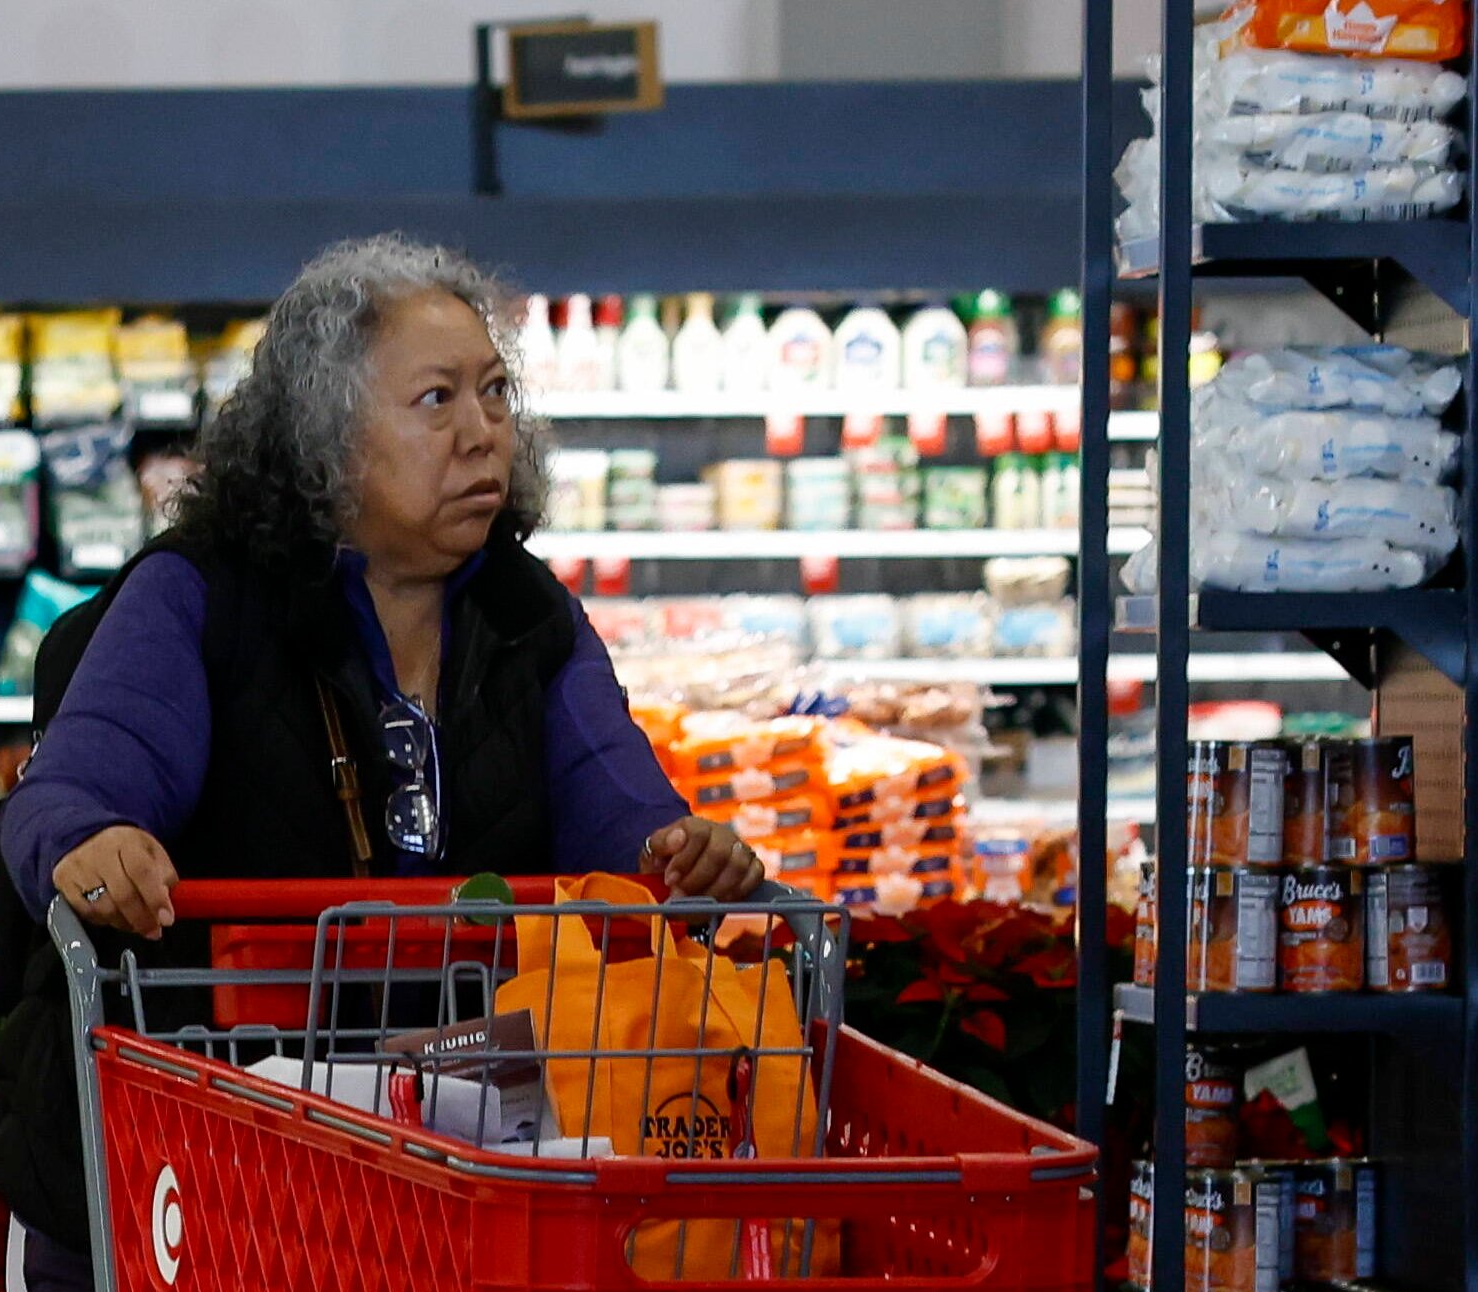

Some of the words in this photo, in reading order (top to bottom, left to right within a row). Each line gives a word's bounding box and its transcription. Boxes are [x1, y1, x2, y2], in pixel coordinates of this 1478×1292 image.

[1281, 873, 1343, 906] Bruce's
[423, 1030, 487, 1056] KURIG
[642, 1115, 732, 1139] TRADER
[659, 1139, 724, 1159] JOE'S
